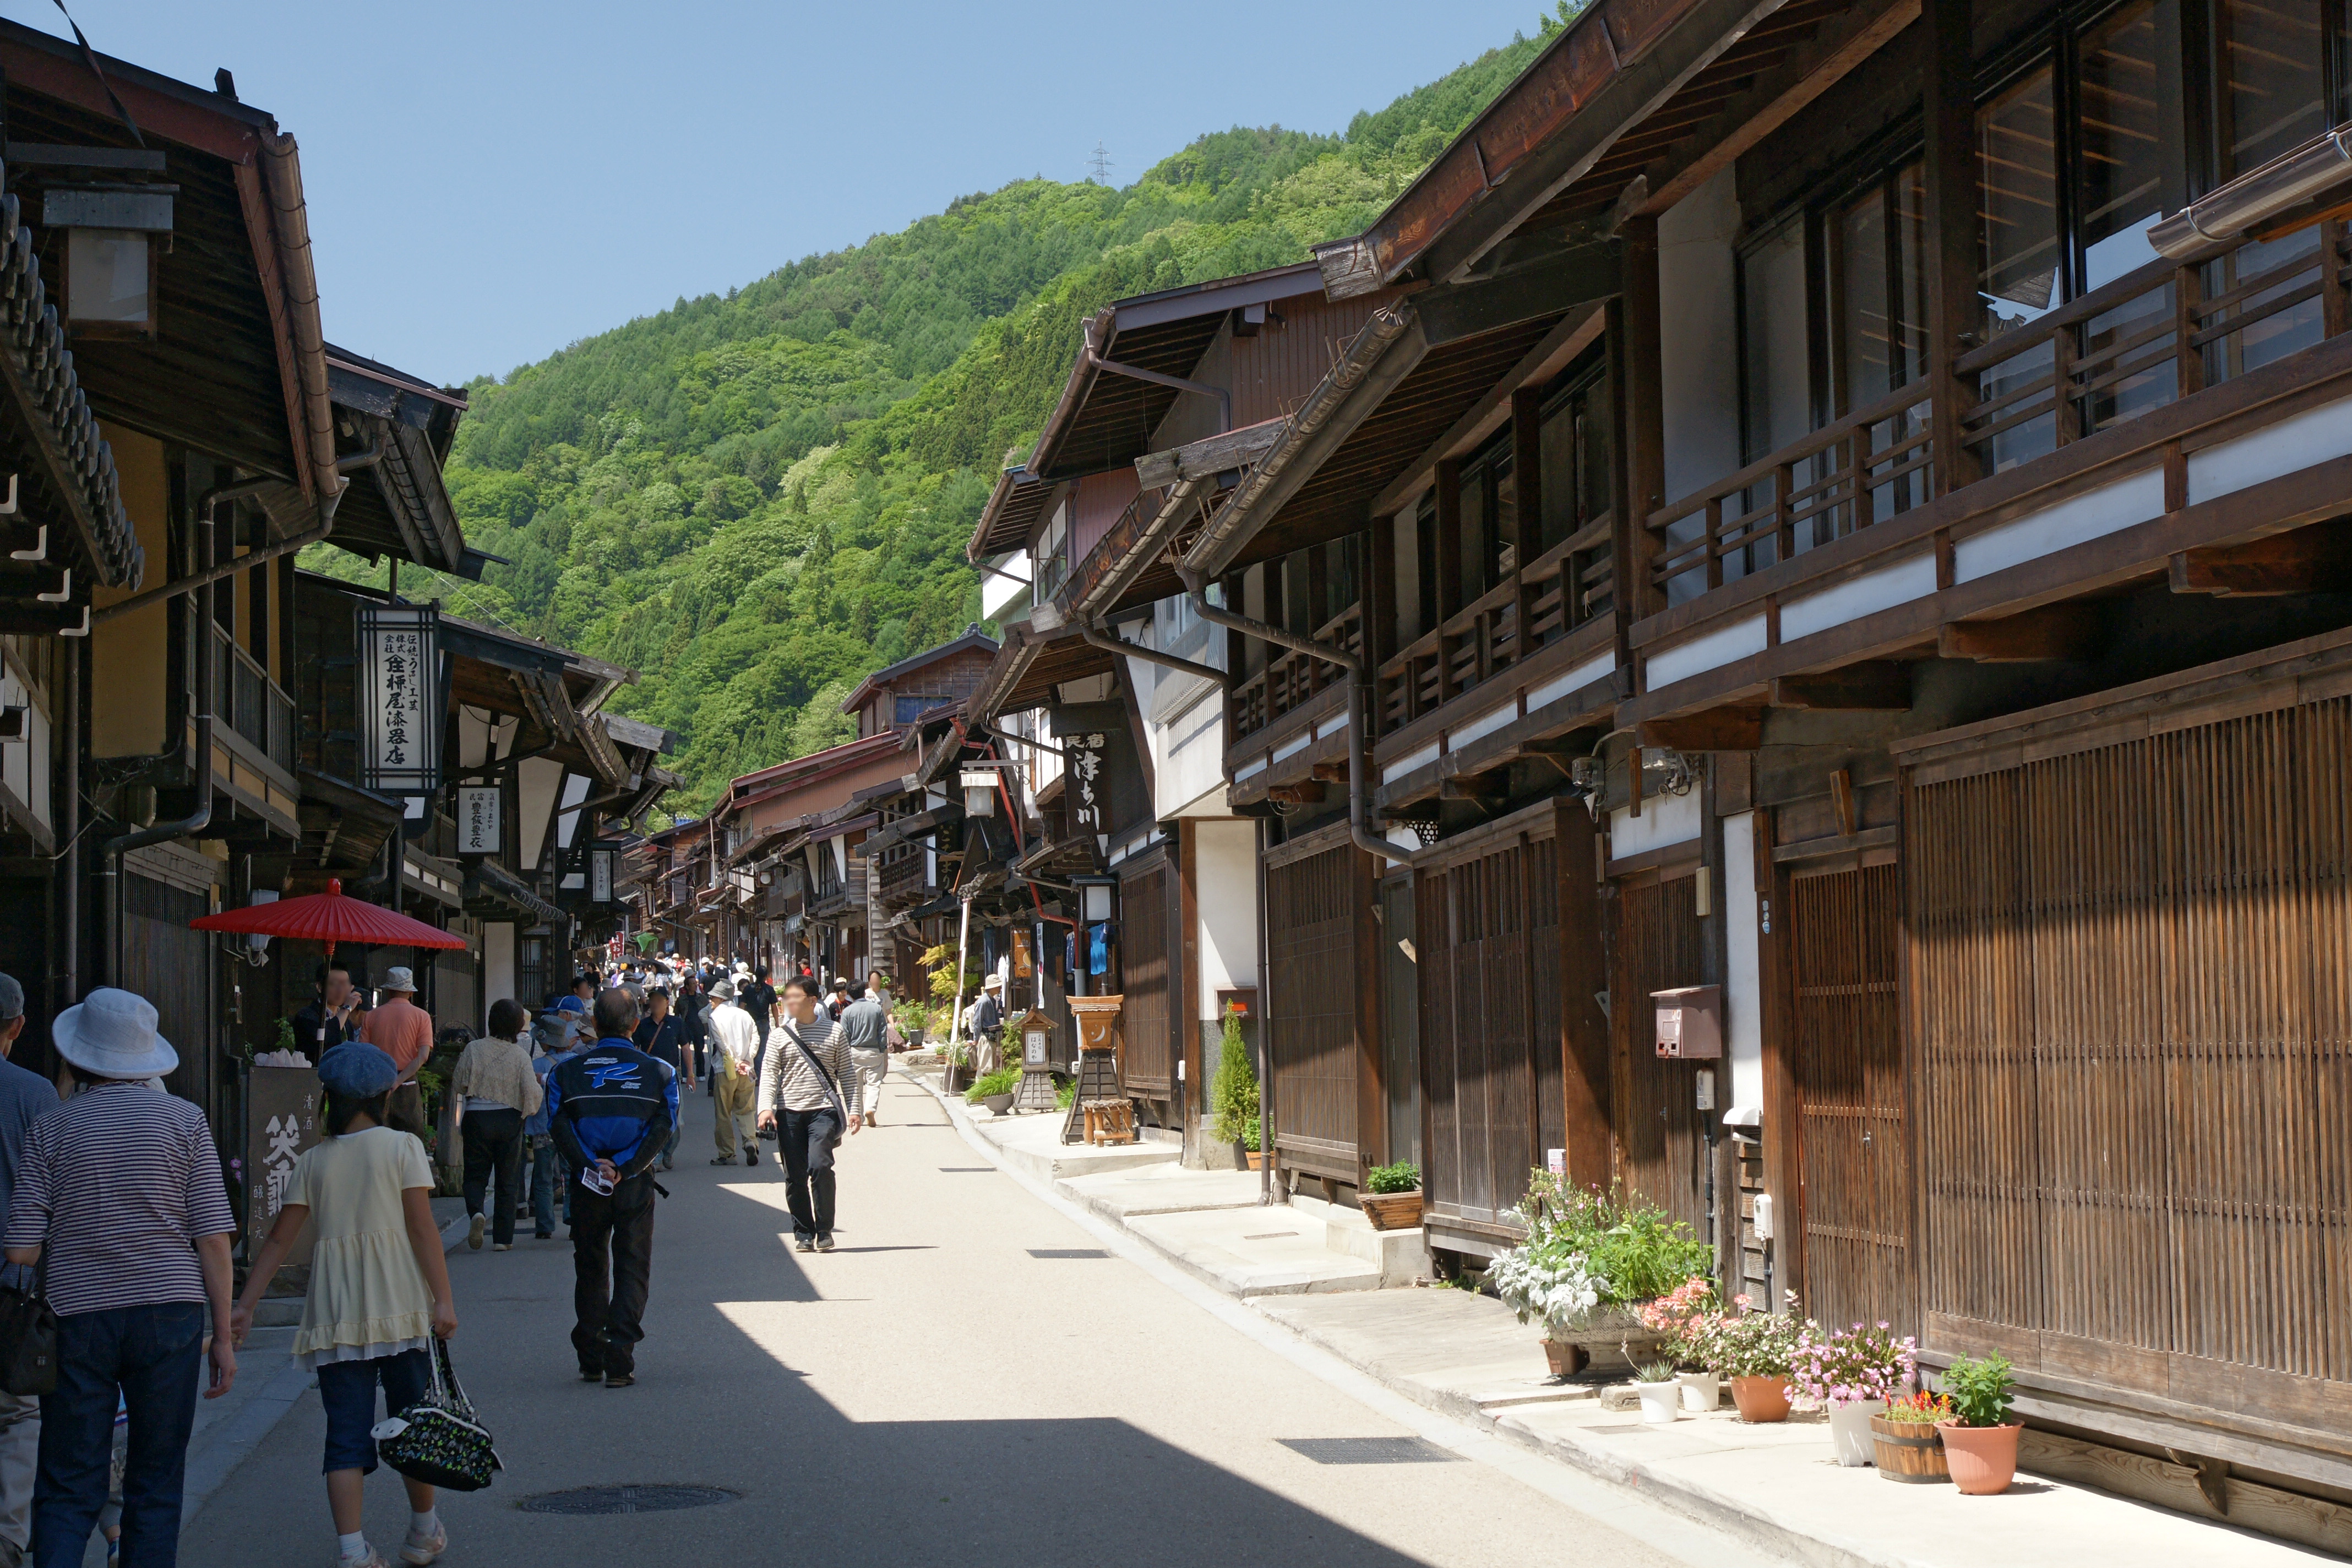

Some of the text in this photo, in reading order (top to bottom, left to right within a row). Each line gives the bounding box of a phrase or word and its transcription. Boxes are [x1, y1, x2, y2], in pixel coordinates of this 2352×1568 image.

[384, 634, 394, 653] 会社
[395, 634, 406, 653] 株式
[1065, 734, 1105, 749] 民宿
[1074, 750, 1102, 831] 津ち川
[303, 1093, 314, 1130] 清酒
